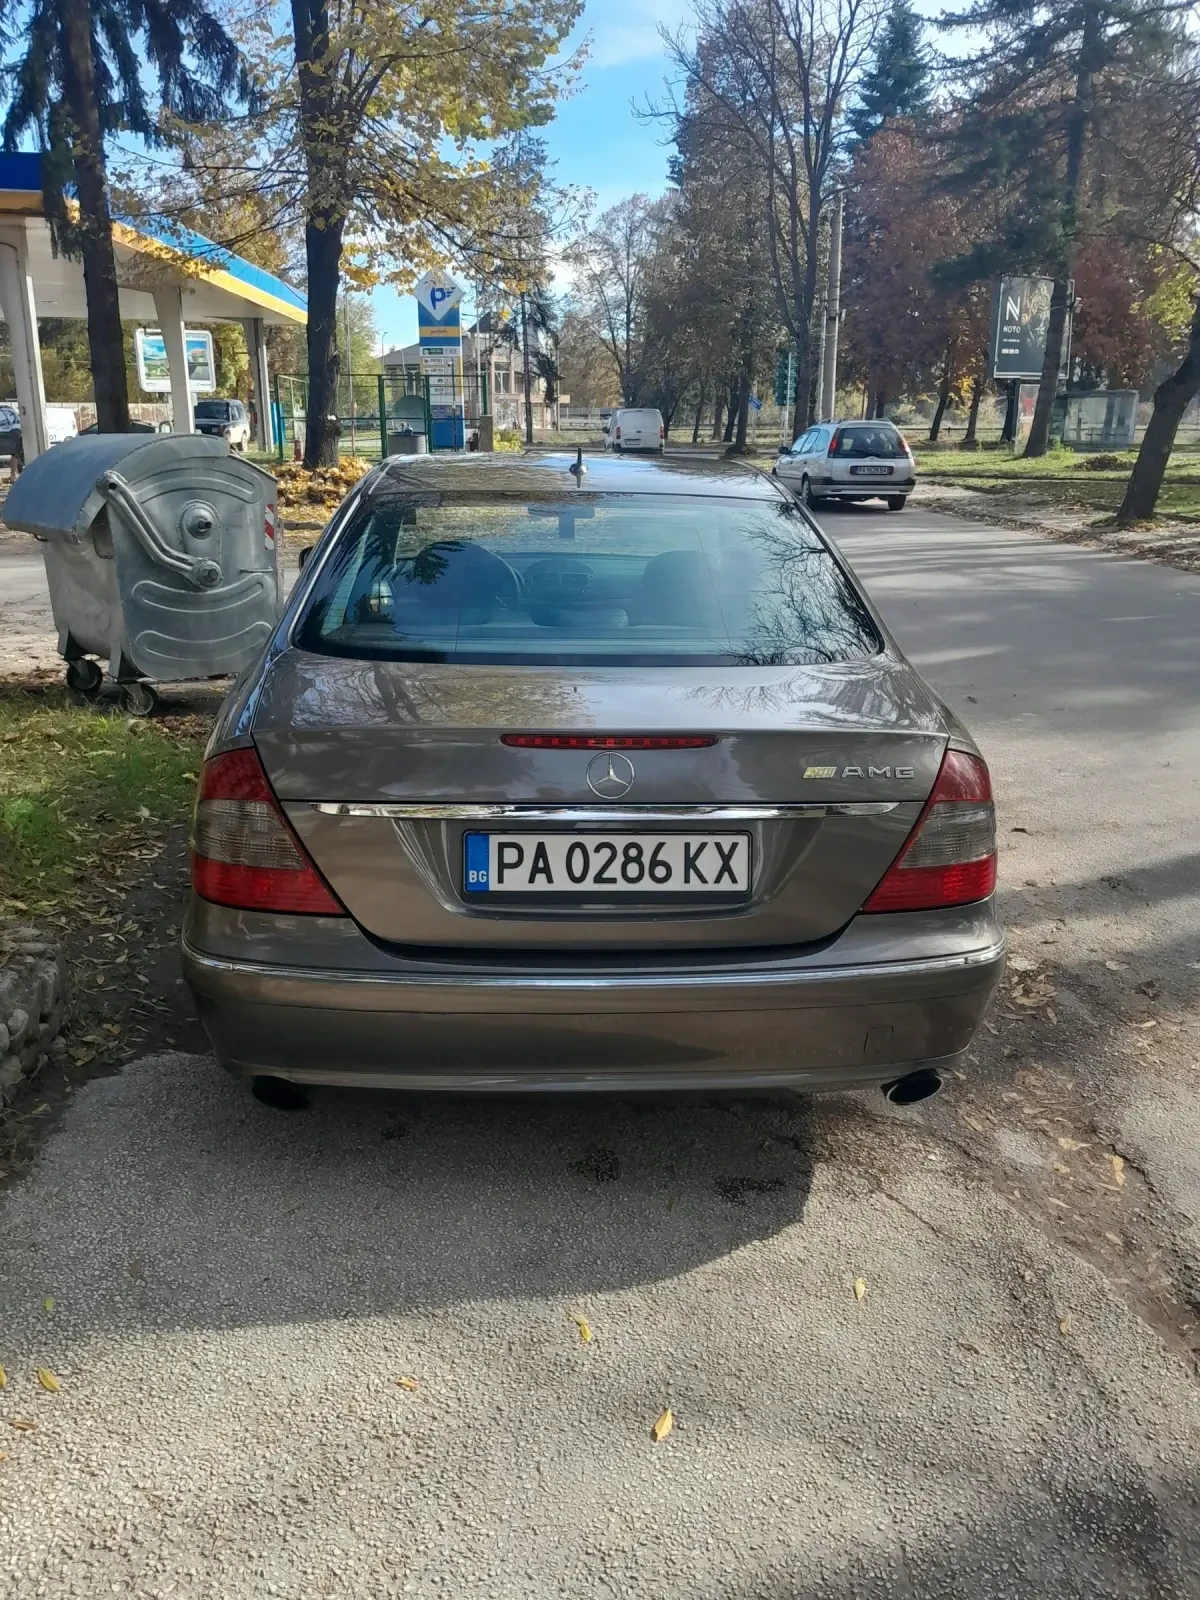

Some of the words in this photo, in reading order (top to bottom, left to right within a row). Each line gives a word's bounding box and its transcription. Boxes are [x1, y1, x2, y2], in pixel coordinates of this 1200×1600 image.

[841, 766, 915, 779] AMG
[497, 841, 554, 885] PA
[565, 841, 673, 885] 0286
[683, 841, 740, 885] KX
[468, 870, 488, 883] BG
